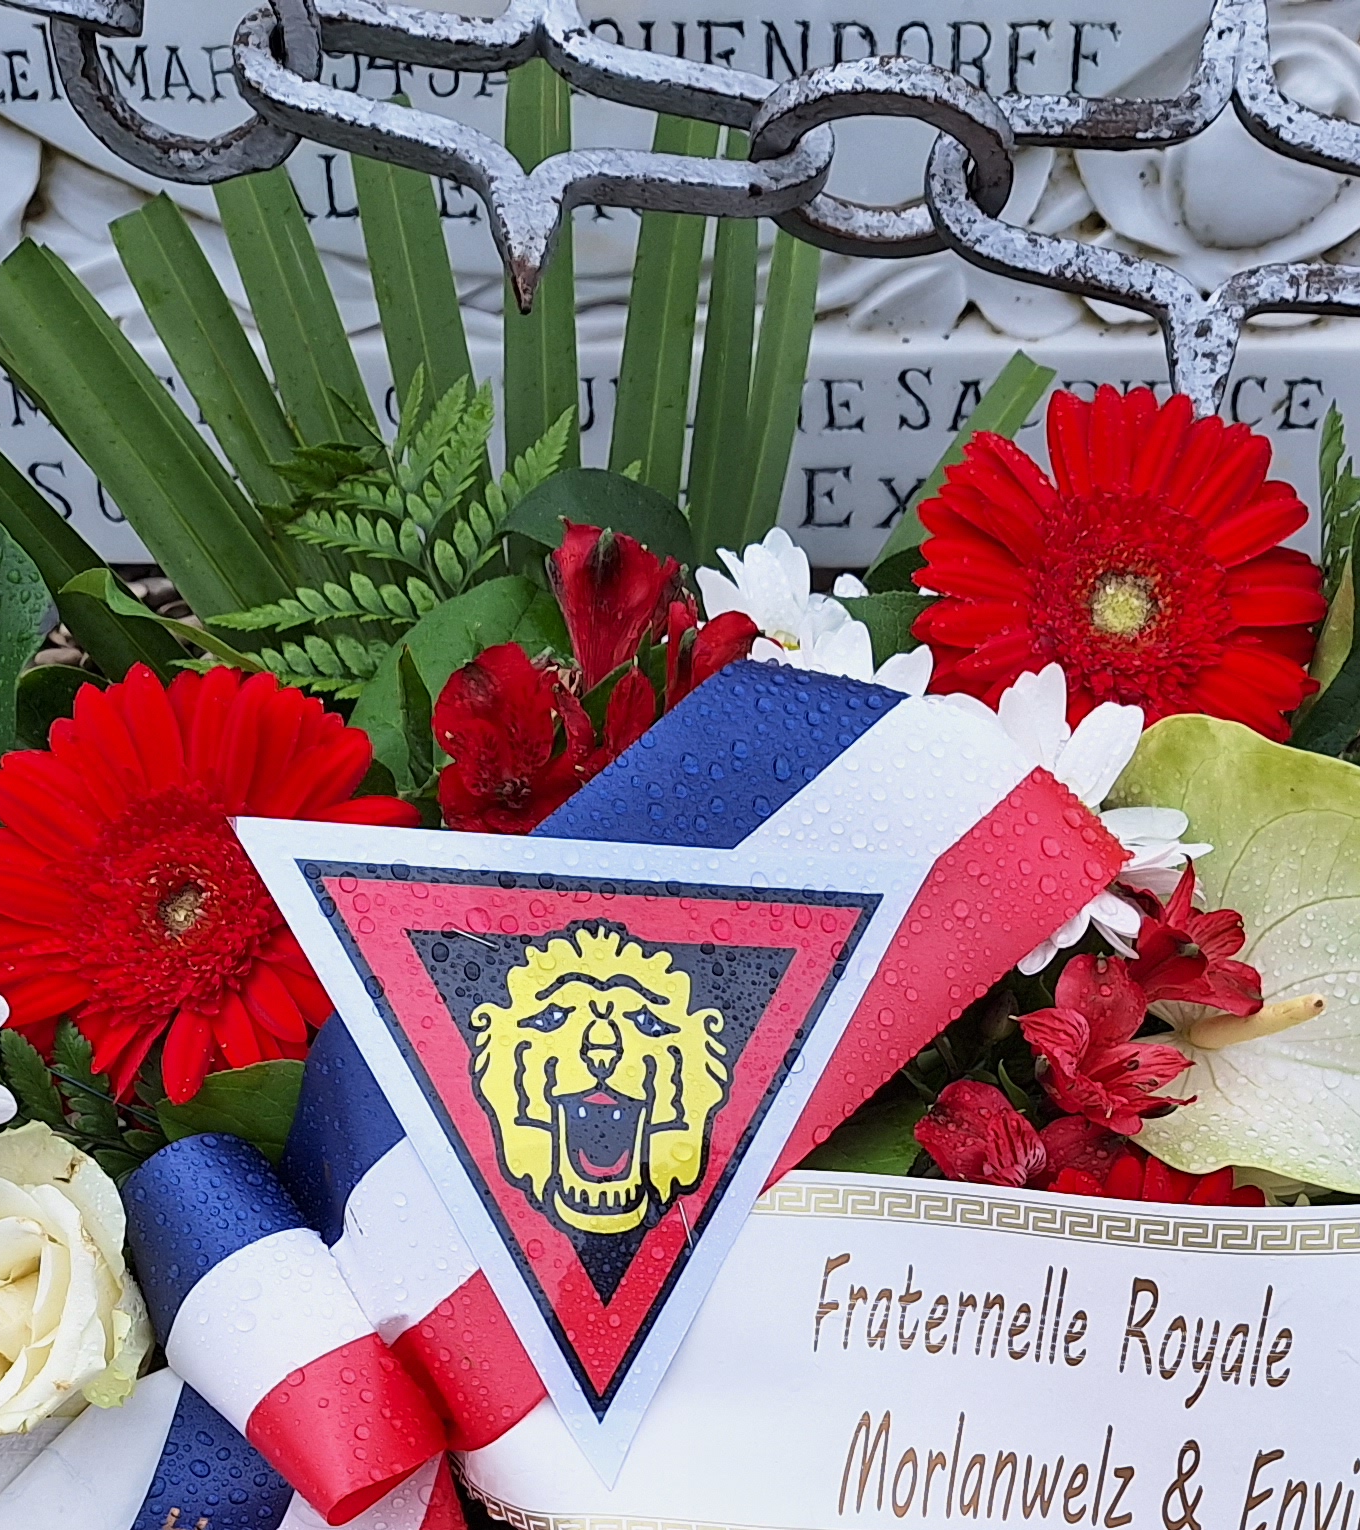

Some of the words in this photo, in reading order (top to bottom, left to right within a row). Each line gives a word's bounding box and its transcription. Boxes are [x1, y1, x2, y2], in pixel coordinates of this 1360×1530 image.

[812, 1252, 1088, 1367] Fraternelle
[1119, 1276, 1293, 1409] Royale
[837, 1409, 1135, 1529] Morlanwelz
